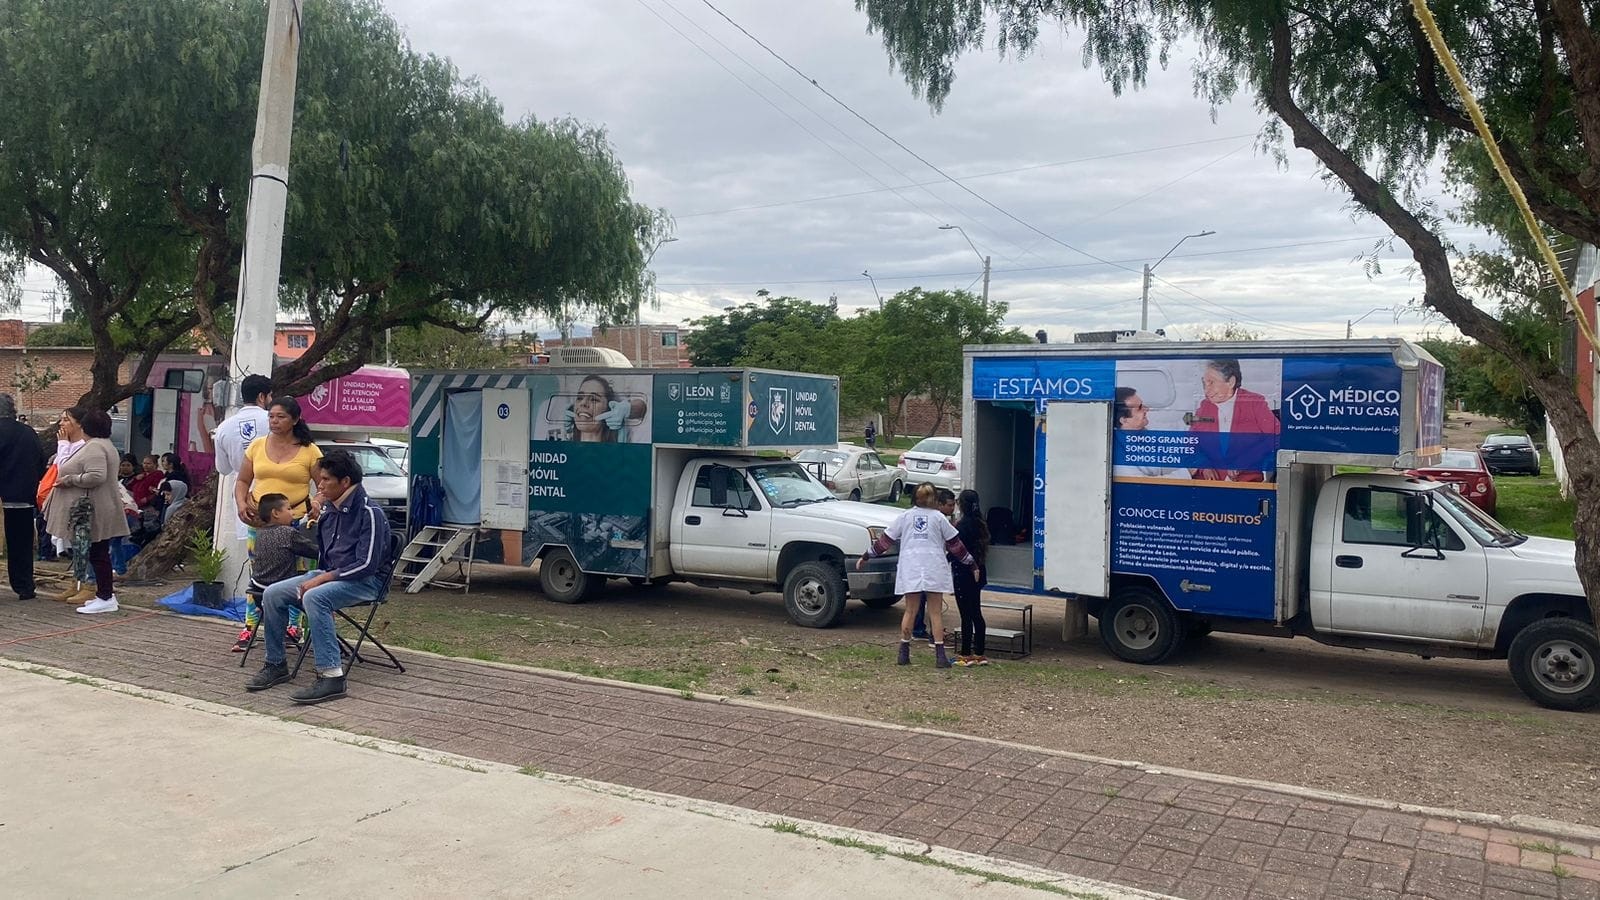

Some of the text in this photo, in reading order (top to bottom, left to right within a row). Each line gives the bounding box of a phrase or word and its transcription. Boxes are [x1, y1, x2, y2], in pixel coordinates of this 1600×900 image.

[366, 381, 384, 390] MÓVIL
[685, 383, 714, 397] LEÓN
[351, 389, 380, 397] ATENCIÓN
[795, 392, 818, 402] UNIDAD
[1328, 385, 1400, 403] MÉDICO
[499, 406, 509, 417] 03
[794, 404, 813, 416] MÓVIL
[1328, 406, 1400, 416] EN TU CASA
[794, 422, 816, 431] DENTAL
[1126, 434, 1199, 445] SOMOS GRANDES
[1125, 444, 1195, 454] SOMOS FUERTES
[529, 452, 568, 464] UNIDAD
[1125, 454, 1181, 464] SOMOS LEÓN
[528, 466, 559, 480] MÓVIL
[528, 486, 566, 498] DENTAL
[1118, 507, 1261, 525] CONOCE LOS REQUISITOS
[1142, 562, 1185, 571] consentimiento
[1186, 565, 1216, 573] informado.
[1219, 561, 1238, 569] digital
[1239, 563, 1249, 571] y/o
[1249, 564, 1272, 572] escrito.
